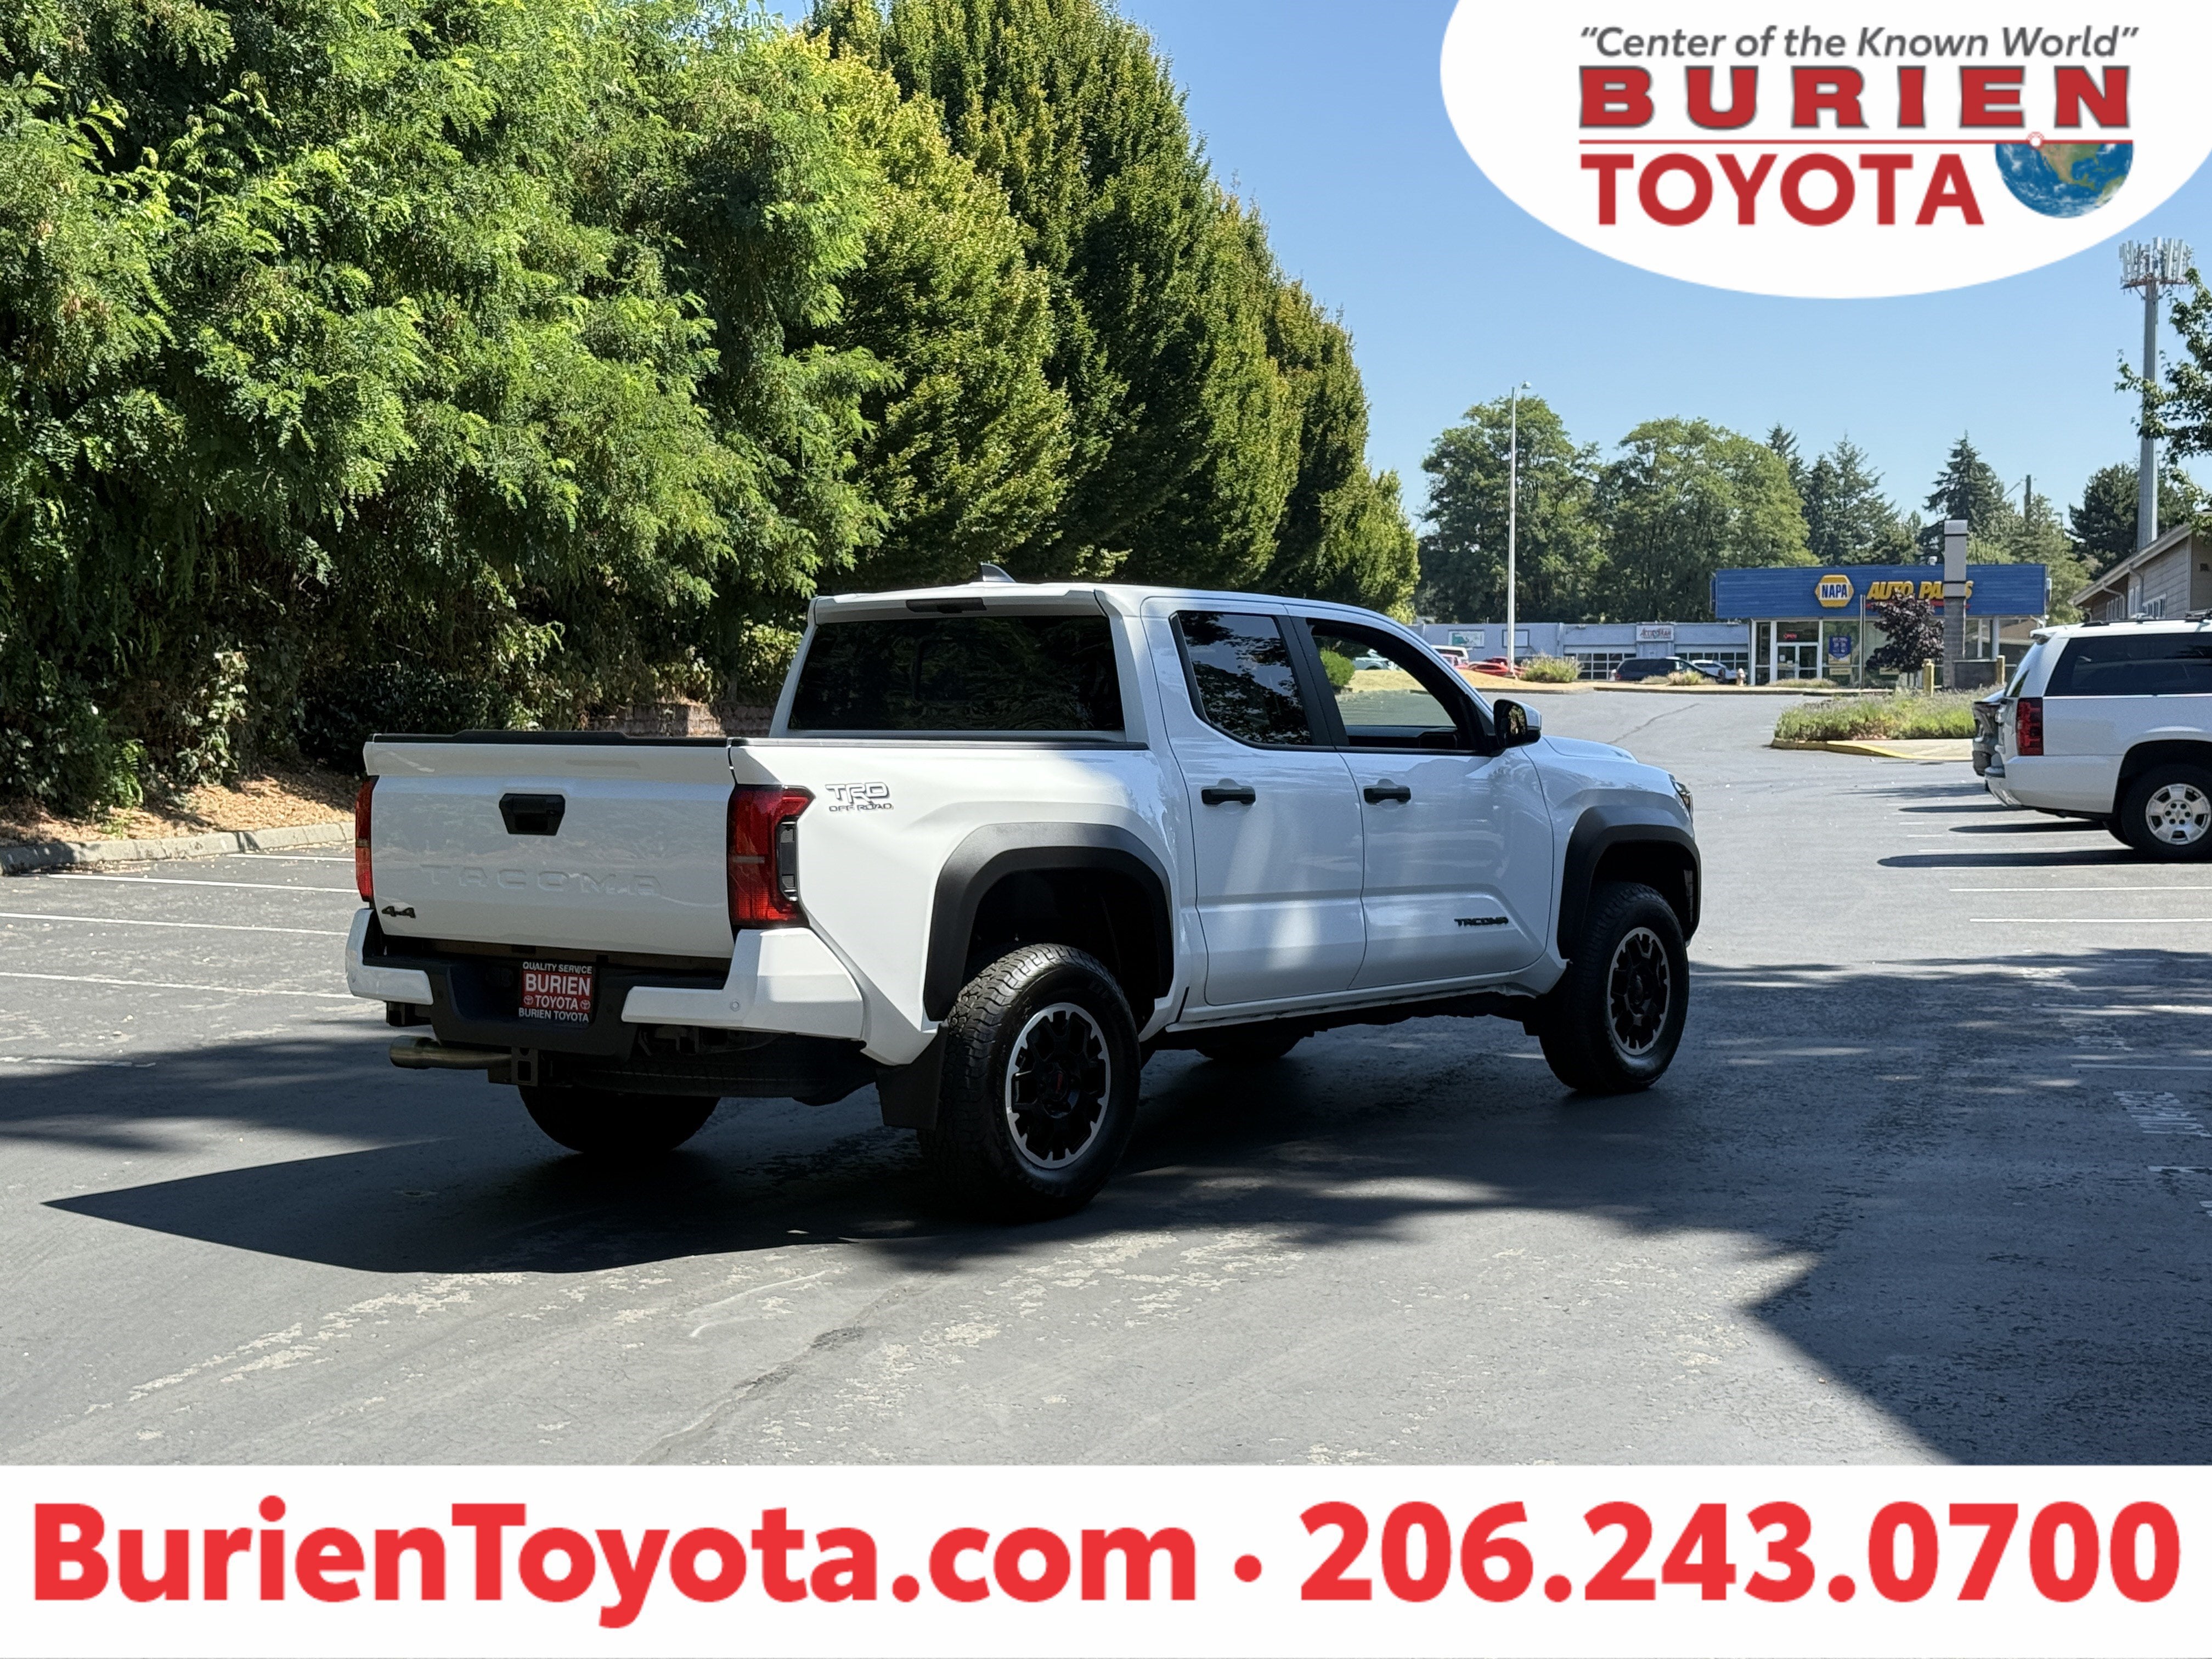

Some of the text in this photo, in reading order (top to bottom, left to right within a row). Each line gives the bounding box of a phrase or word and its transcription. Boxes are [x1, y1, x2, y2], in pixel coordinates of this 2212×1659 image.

[1821, 580, 1974, 600] NAPA AUTO PAS
[825, 782, 890, 804] TRD
[857, 803, 894, 811] ROAD
[419, 864, 662, 897] TACOMA
[1454, 915, 1509, 927] TACOMA
[522, 961, 592, 974] QUALITY SERVICE
[525, 973, 591, 996] BURIEN
[534, 995, 579, 1011] TOYOTA
[518, 1007, 589, 1023] BURIEN TOYOTA
